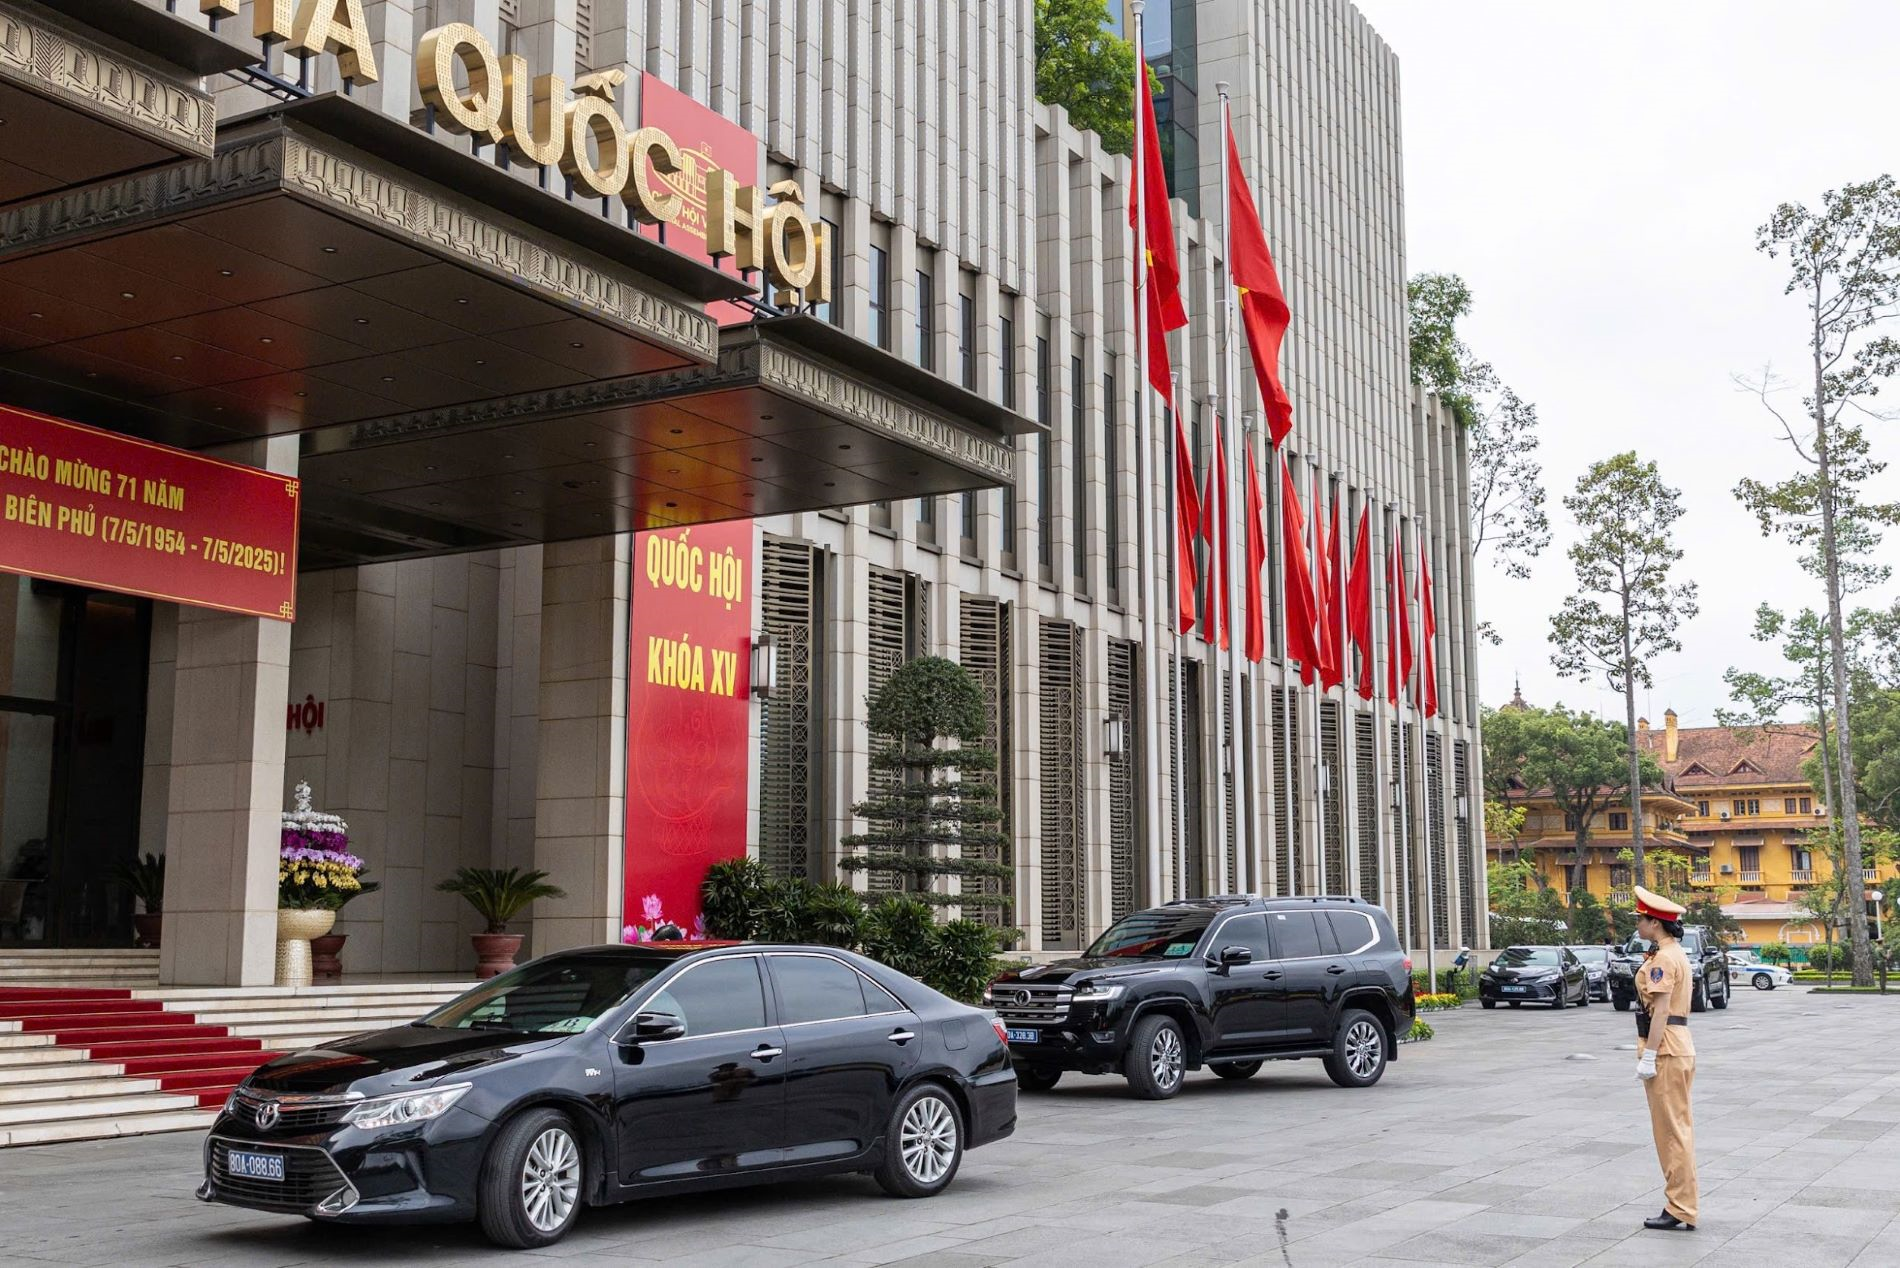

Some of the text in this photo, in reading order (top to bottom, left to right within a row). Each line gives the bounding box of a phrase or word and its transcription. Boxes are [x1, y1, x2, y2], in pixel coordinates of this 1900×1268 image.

[416, 22, 682, 225] QUỐC
[706, 168, 832, 307] HỘI
[0, 445, 185, 511] CHÀO MỪNG 71 NĂM
[5, 494, 52, 528] BIÊN
[57, 503, 96, 537] PHỦ
[101, 515, 186, 555] (7/5/1954
[202, 536, 285, 575] 7/5/2025)!
[646, 528, 742, 610] QUỐC HỘI
[647, 633, 737, 697] KHÓA XV
[286, 694, 325, 736] HỘI
[230, 1153, 282, 1178] 80A-088.66
